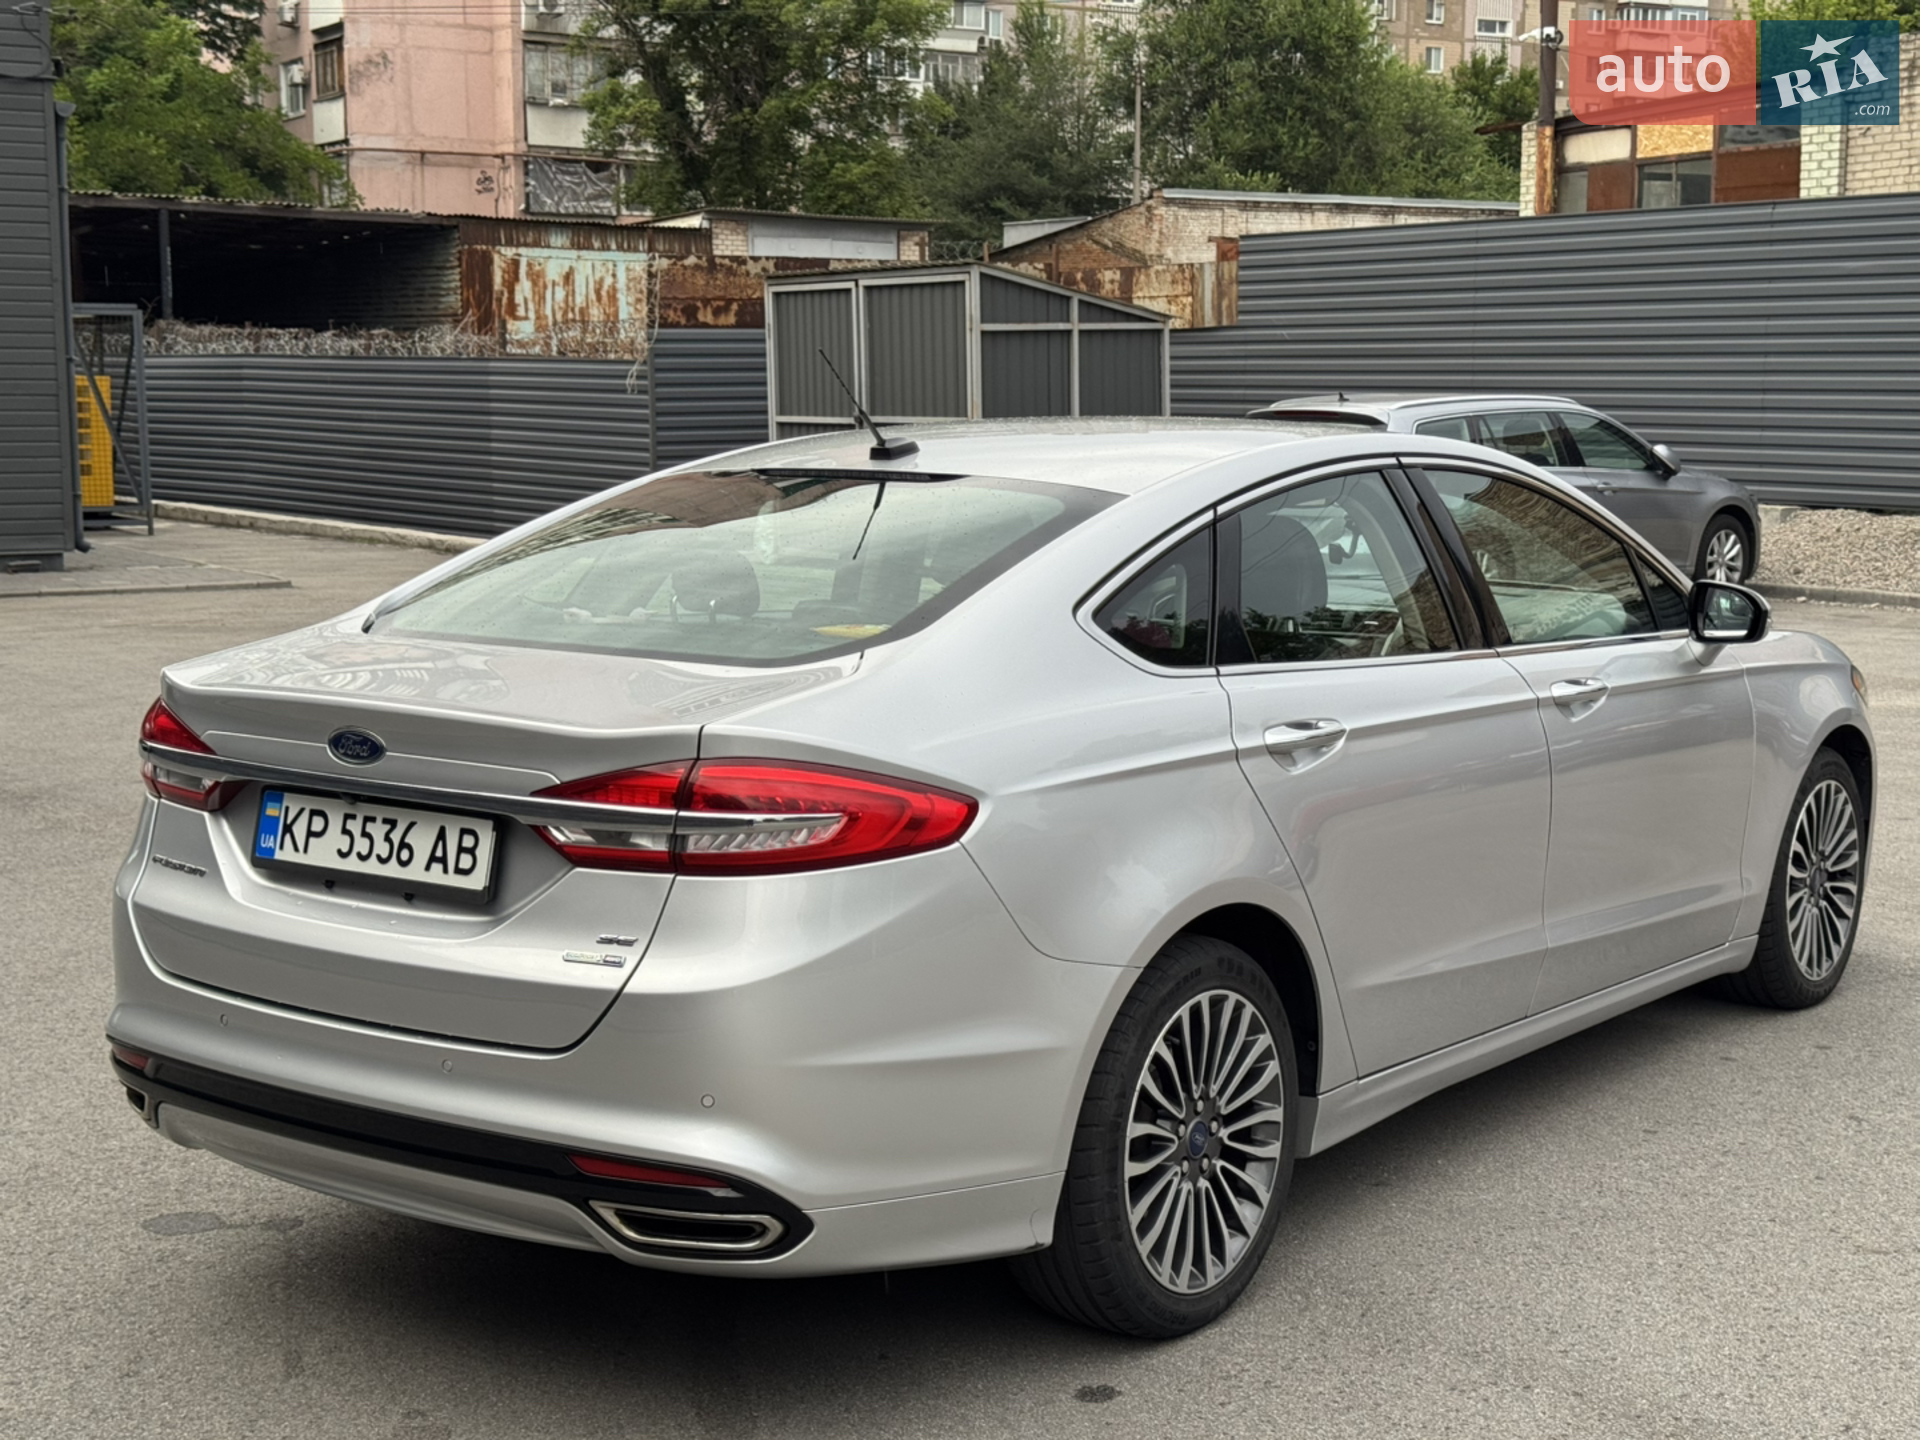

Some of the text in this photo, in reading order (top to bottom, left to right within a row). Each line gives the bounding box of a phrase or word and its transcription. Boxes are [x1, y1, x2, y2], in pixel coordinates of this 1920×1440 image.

[260, 833, 275, 849] UA
[279, 805, 480, 876] KP 5536 AB
